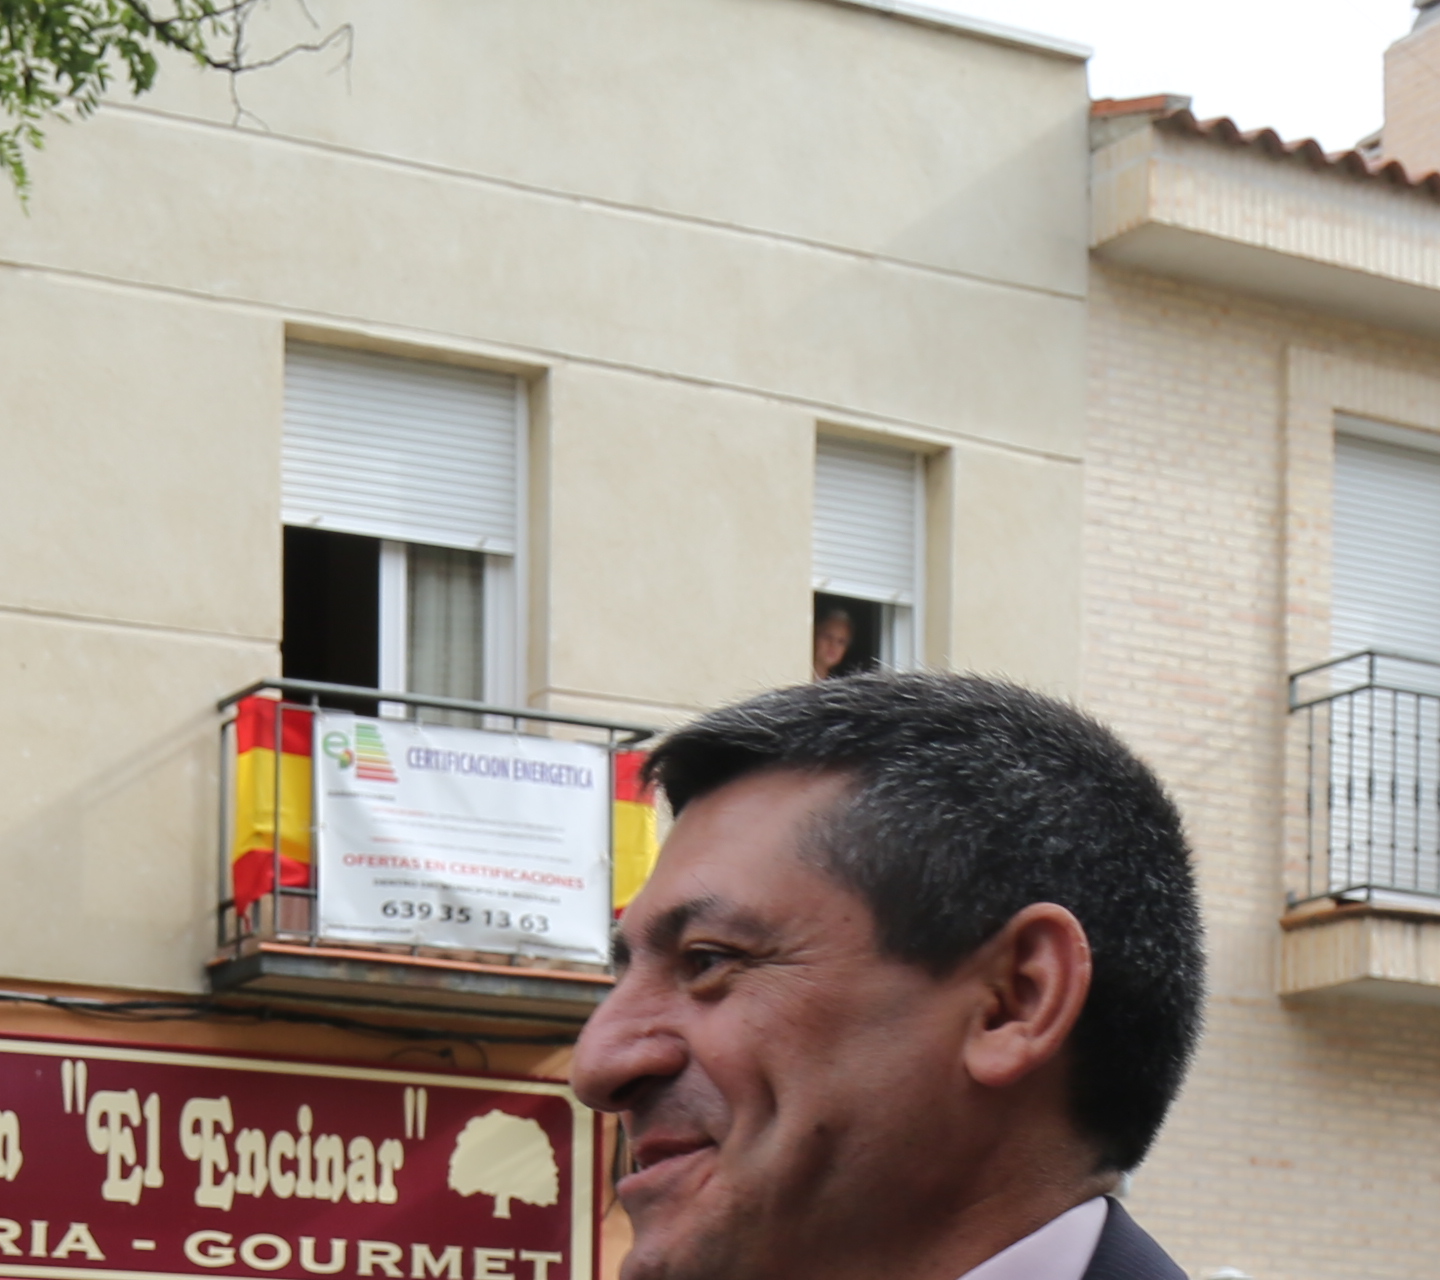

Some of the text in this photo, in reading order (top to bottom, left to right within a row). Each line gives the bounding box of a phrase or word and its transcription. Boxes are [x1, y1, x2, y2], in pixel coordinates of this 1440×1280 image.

[342, 853, 421, 871] OFERTAS
[424, 860, 447, 873] EN
[449, 863, 585, 891] CERTIFICACIONES
[381, 899, 550, 934] 639 35 13 63
[61, 1058, 164, 1206] "El
[178, 1086, 428, 1213] Encinar"
